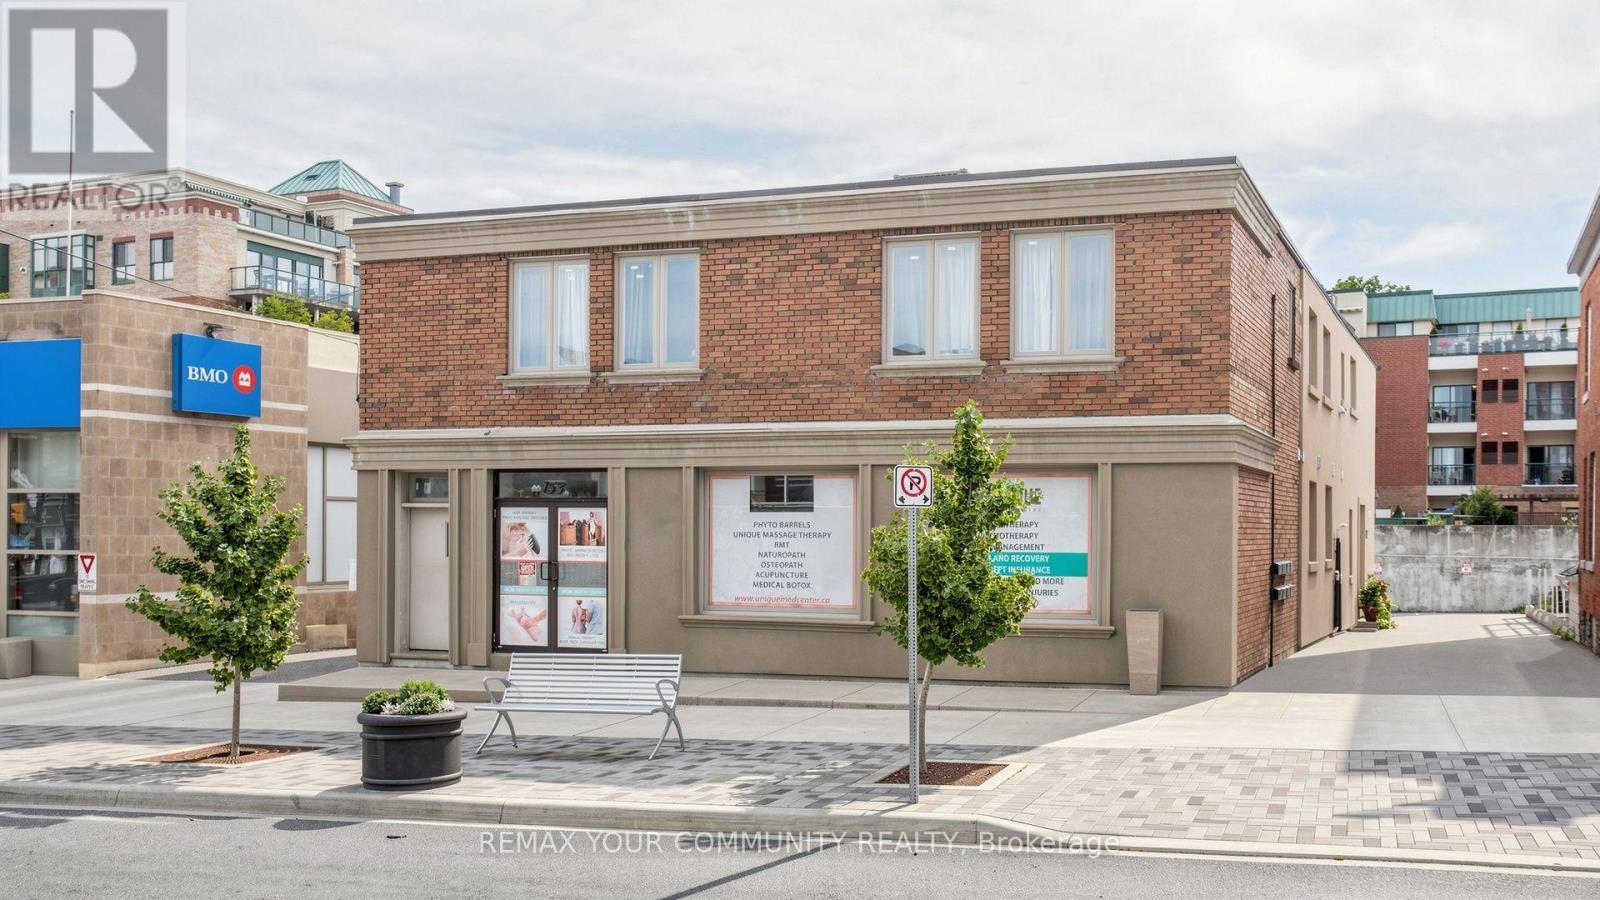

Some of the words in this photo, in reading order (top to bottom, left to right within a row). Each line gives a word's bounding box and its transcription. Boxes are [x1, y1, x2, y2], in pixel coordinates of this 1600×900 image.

[187, 366, 228, 384] BMO
[753, 521, 778, 529] PHYTO
[779, 521, 811, 529] BARRELS
[733, 531, 761, 539] UNIQUE
[762, 531, 797, 539] MASSAGE
[998, 532, 1039, 540] OTHERAPY
[774, 541, 789, 549] RMT
[758, 551, 806, 559] NATUROPATH
[760, 561, 803, 569] OSTEOPATH
[755, 571, 809, 579] ACUPUNCTURE
[752, 581, 784, 589] MEDICAL
